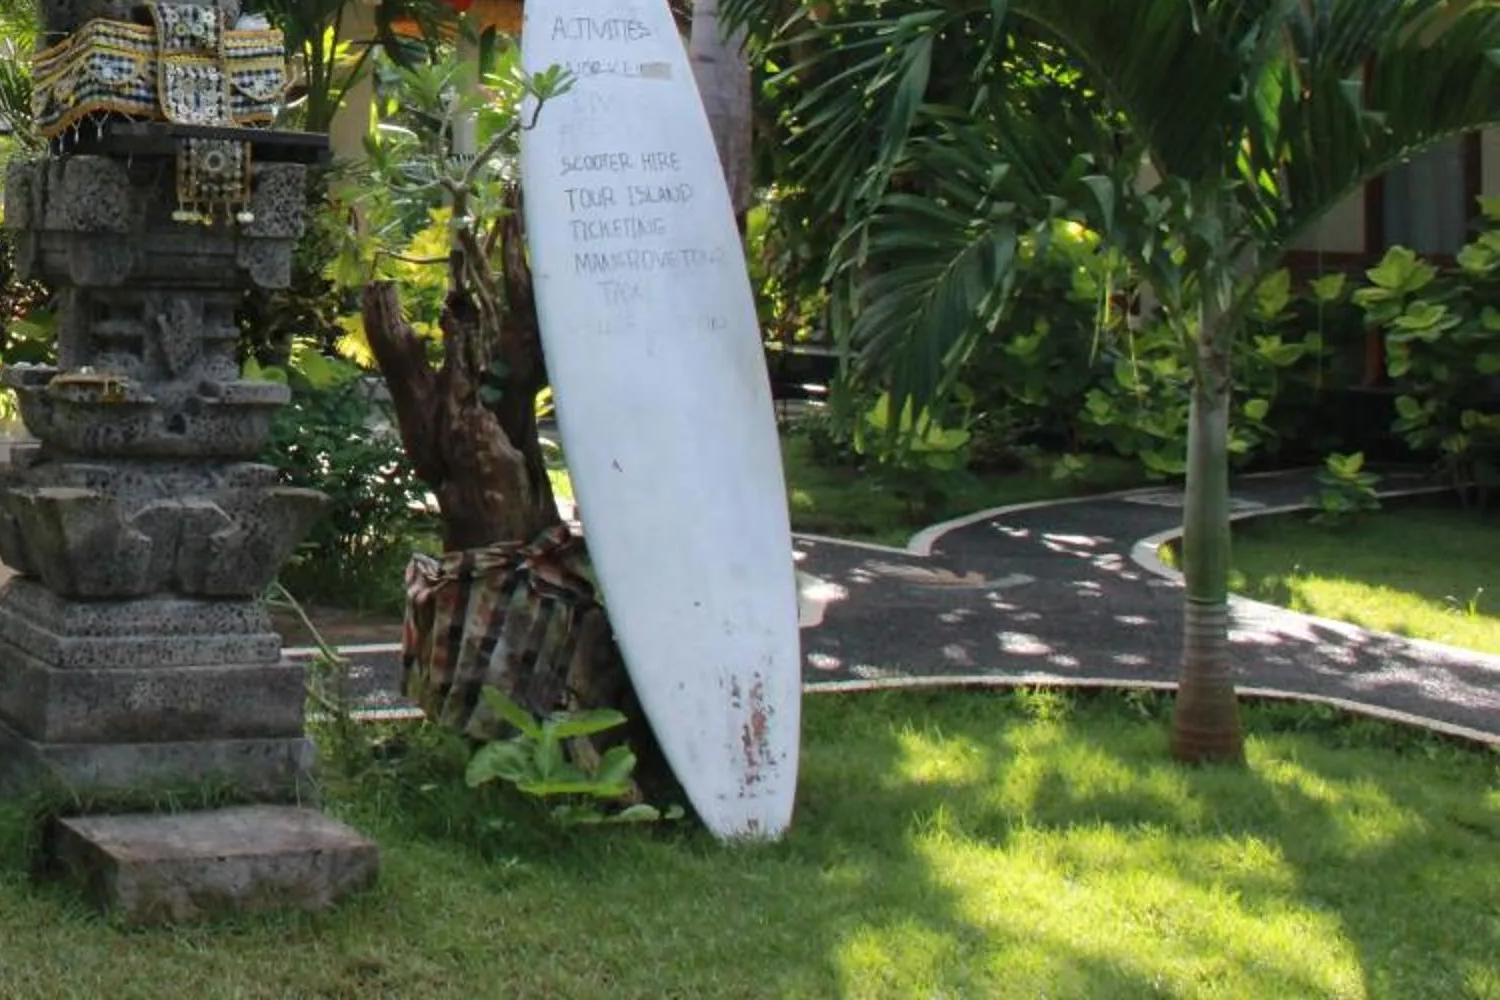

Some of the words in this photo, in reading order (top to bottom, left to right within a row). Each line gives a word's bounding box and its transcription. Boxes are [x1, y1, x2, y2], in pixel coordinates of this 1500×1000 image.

[551, 16, 652, 43] ACTIVITIES
[560, 152, 633, 176] SCOOTER
[641, 151, 681, 172] HIRE
[564, 186, 617, 212] TOUR
[627, 183, 693, 206] ISLAND
[569, 217, 666, 241] TICKETING
